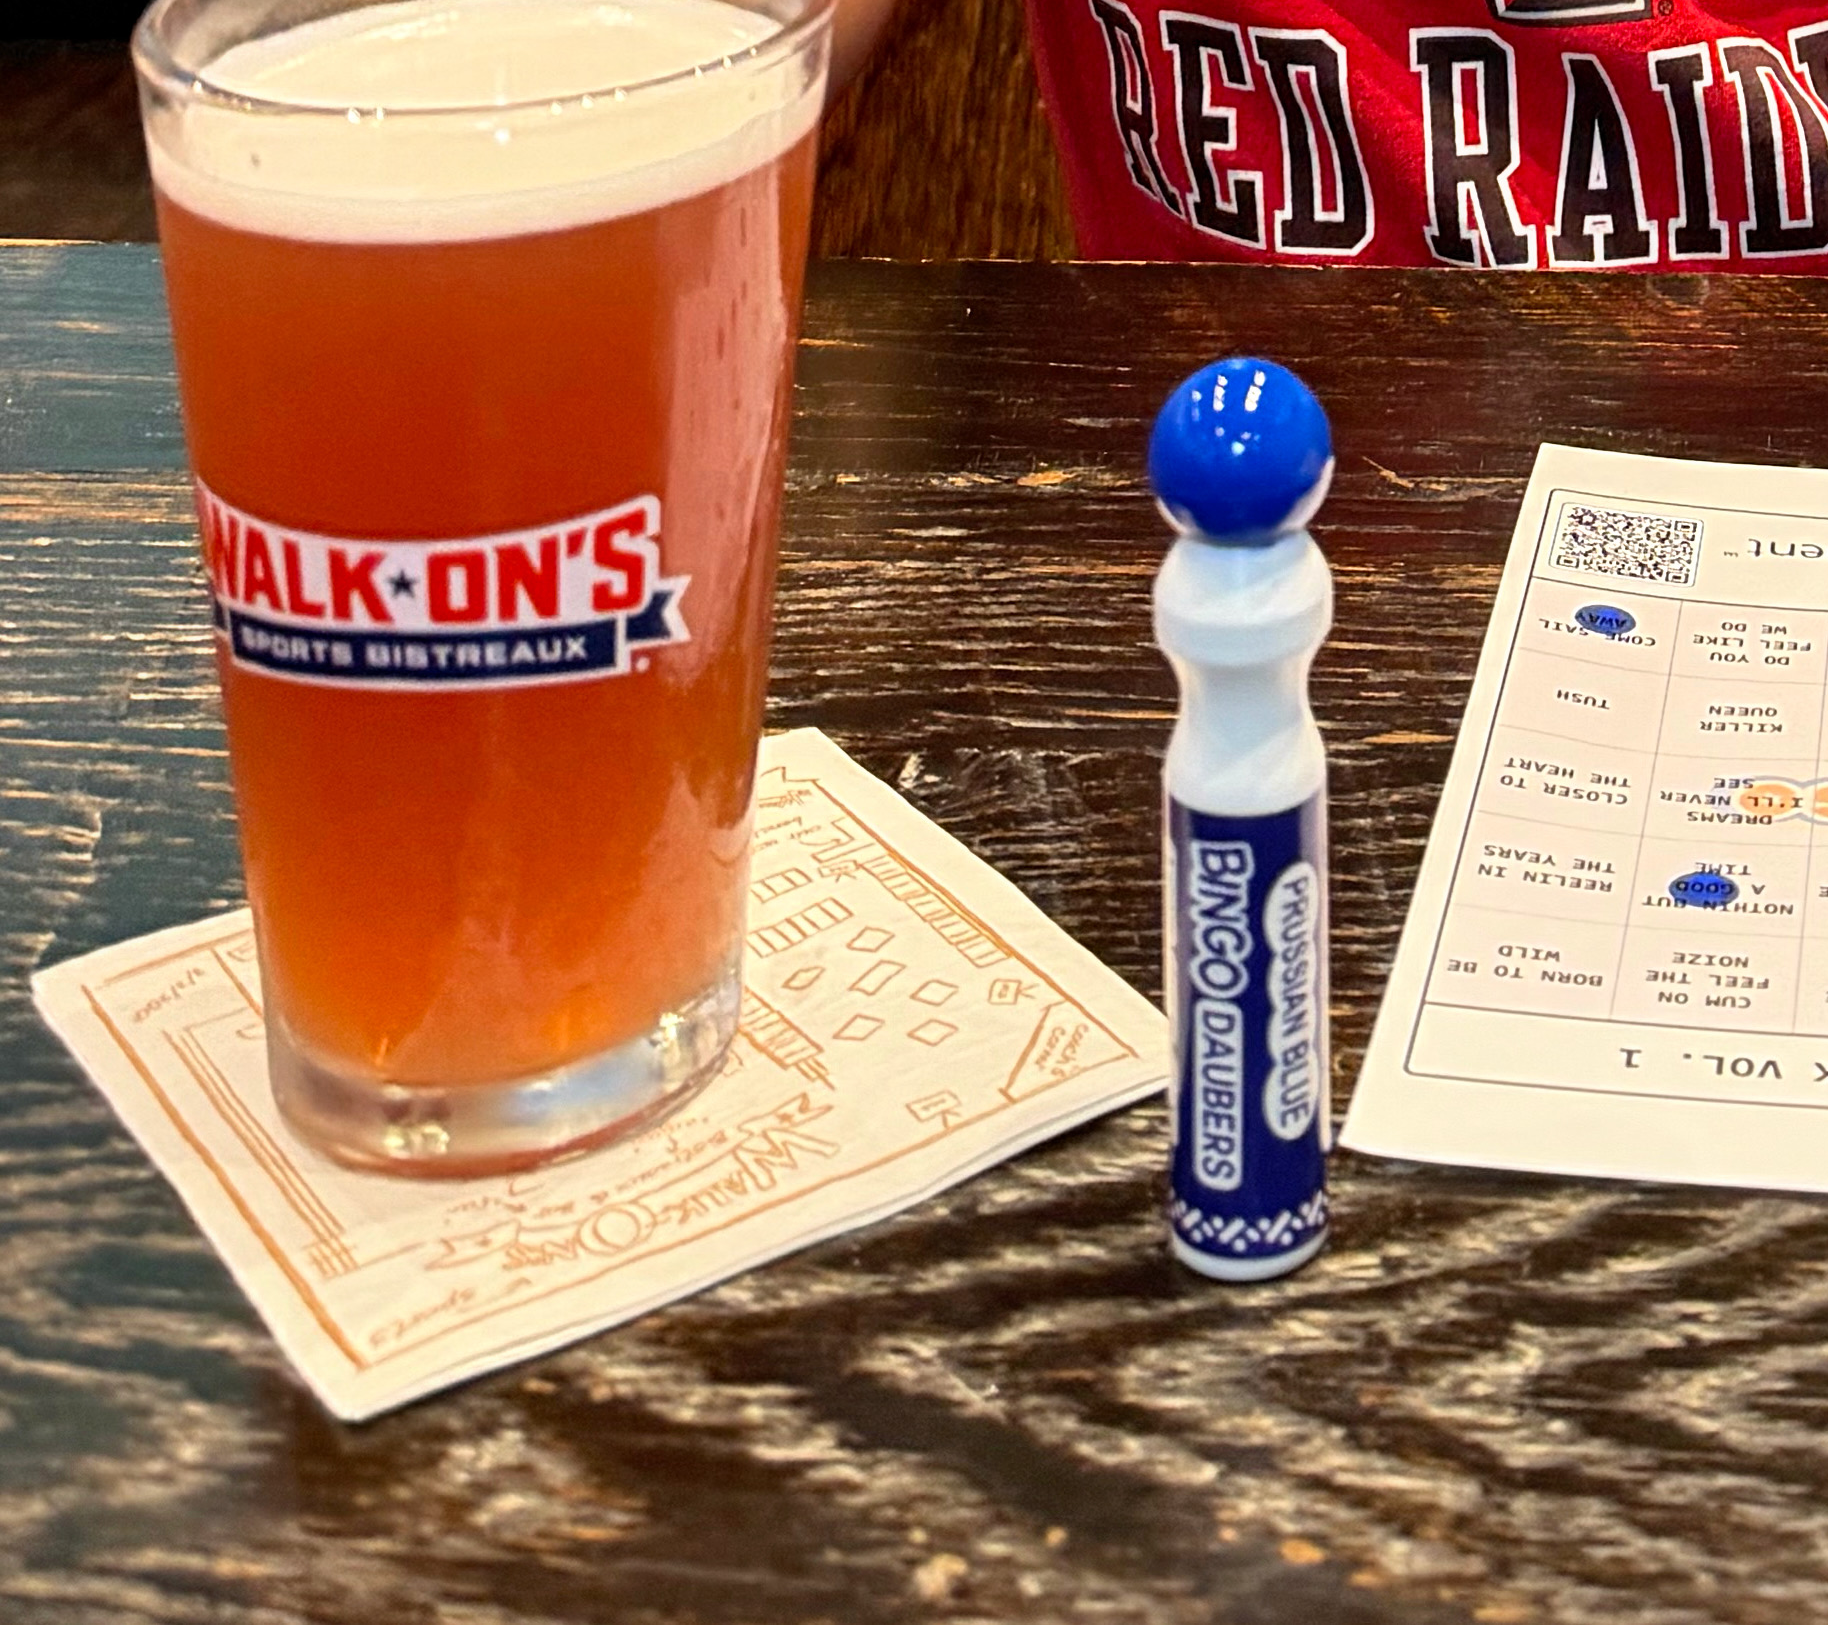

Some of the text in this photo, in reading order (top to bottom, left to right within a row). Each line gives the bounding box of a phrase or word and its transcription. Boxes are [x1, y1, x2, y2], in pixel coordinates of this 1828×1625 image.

[1538, 618, 1657, 647] COME SAIL
[1721, 621, 1788, 635] WE DO
[240, 626, 588, 670] SPORTS BISTREAUX
[1692, 635, 1811, 651] FEEL LIKE
[1709, 651, 1790, 666] DO YOU
[1556, 689, 1610, 710] TUSH
[1708, 705, 1778, 717] QUEEN
[1699, 720, 1783, 733] KILLER
[1503, 756, 1630, 788] THE HEART
[1499, 774, 1628, 805] CLOSER TO
[1713, 777, 1755, 789] SEE
[1660, 790, 1804, 809] I'LL NEVER
[1686, 811, 1773, 826] DREAMS
[1483, 844, 1614, 874] THE YEARS
[1478, 863, 1612, 893] REELIN IN
[1695, 862, 1751, 876] TIME
[1675, 879, 1765, 895] A GOOD
[1703, 899, 1793, 916] NOTHIN
[1498, 945, 1561, 963] WILD
[1671, 951, 1749, 969] NOIZE
[1447, 959, 1603, 987] BORN TO BE
[1645, 969, 1769, 989] FEEL THE
[1279, 876, 1311, 1131] PRUSSIAN BLUE
[1658, 991, 1751, 1009] CUM ON
[1195, 842, 1250, 1183] BINGO DAUBERS
[1619, 1048, 1642, 1068] 1
[1683, 1053, 1782, 1080] VOL.
